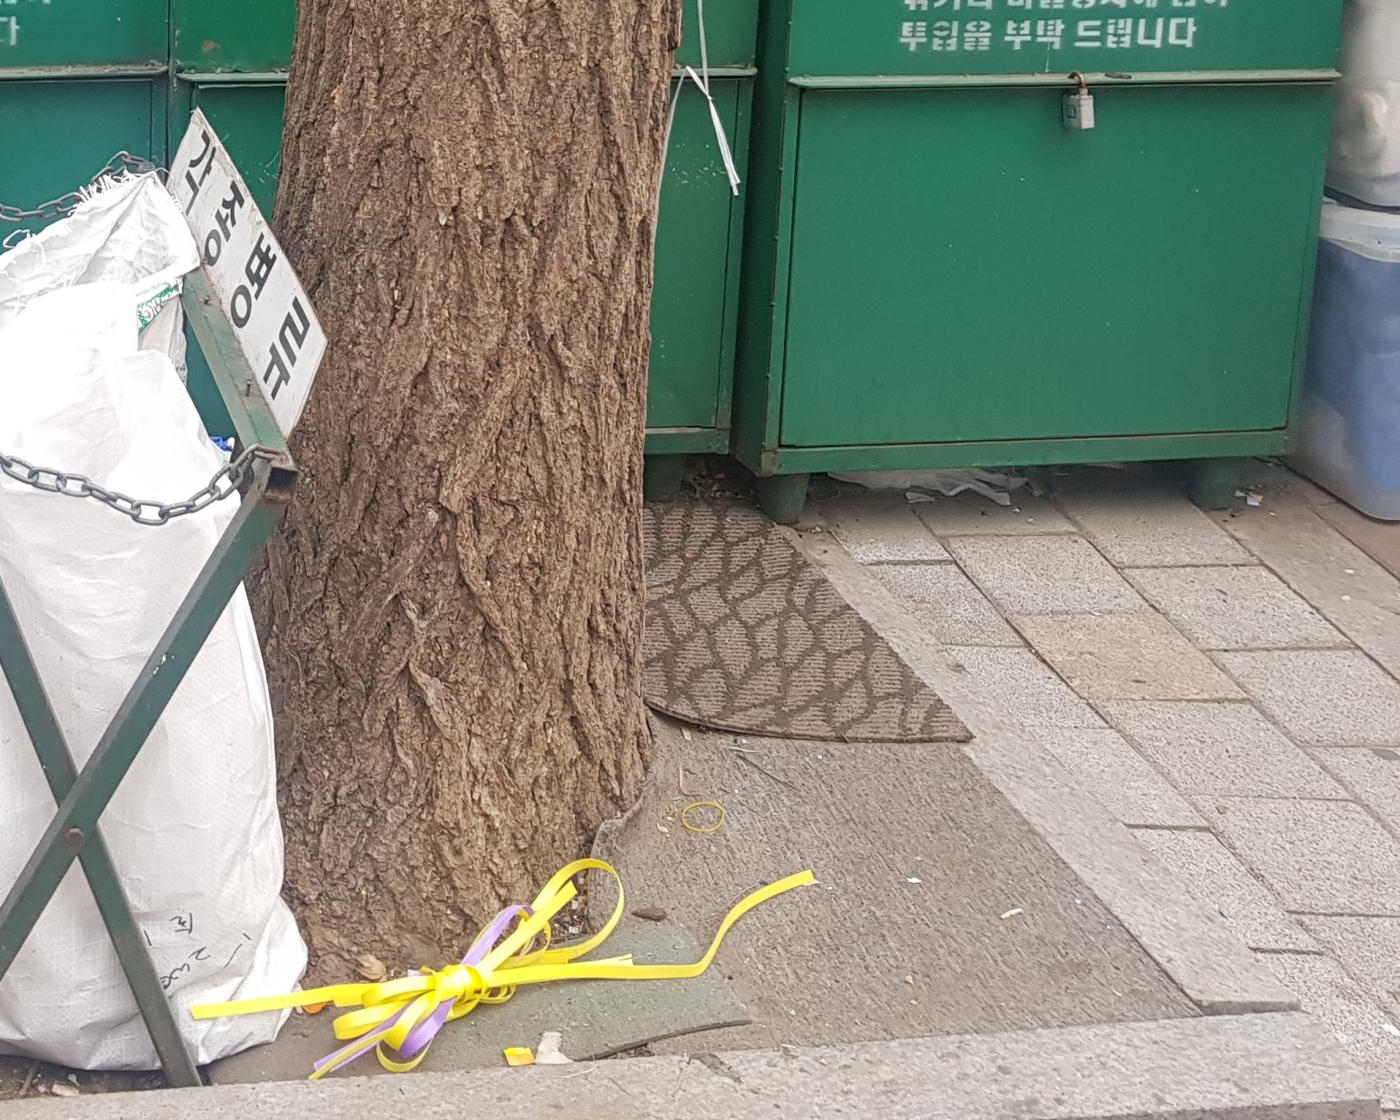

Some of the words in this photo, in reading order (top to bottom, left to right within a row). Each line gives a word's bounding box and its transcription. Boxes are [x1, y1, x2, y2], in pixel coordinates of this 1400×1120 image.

[900, 21, 992, 51] 투입을
[1004, 19, 1065, 50] 부탁
[1074, 17, 1197, 48] 드립니다
